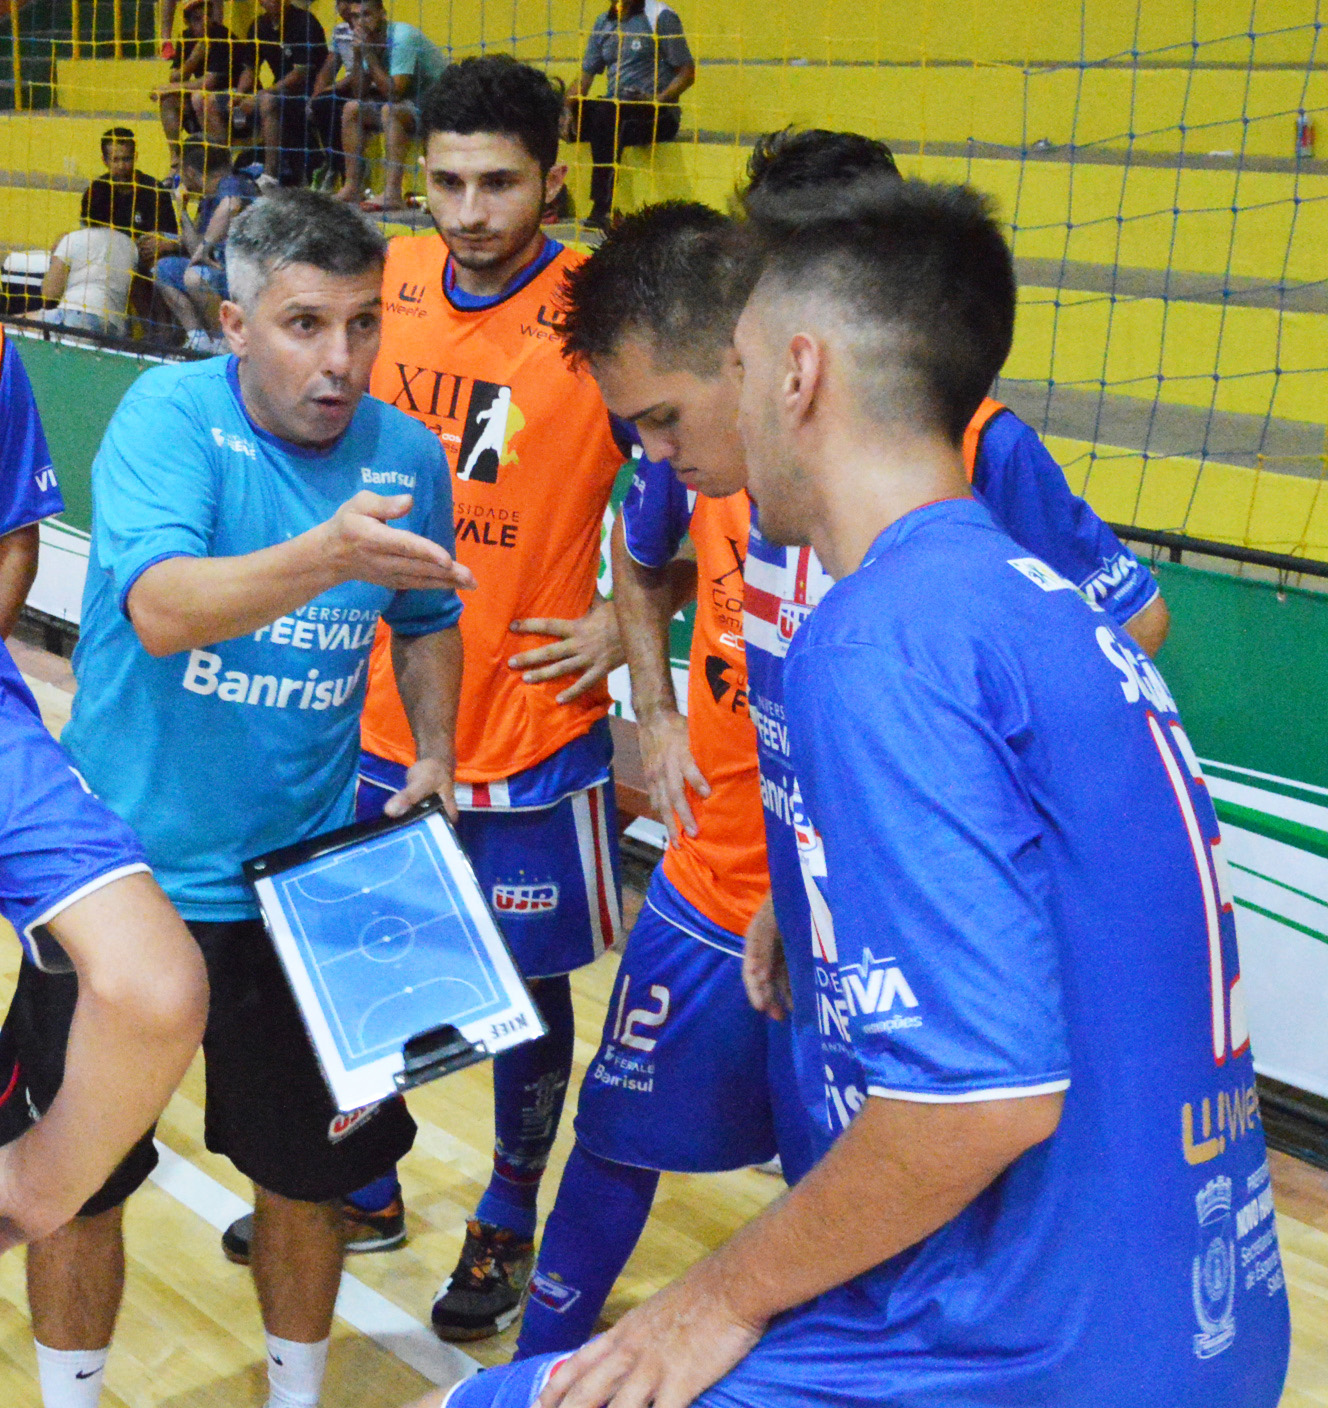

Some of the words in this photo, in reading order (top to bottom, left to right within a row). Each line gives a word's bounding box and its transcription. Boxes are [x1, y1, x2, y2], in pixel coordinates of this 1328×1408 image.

[520, 324, 566, 342] Wee
[390, 362, 468, 421] XII
[457, 503, 520, 523] SIDADE
[182, 648, 365, 711] Banrisul
[495, 887, 554, 911] UJR
[613, 974, 670, 1053] 12
